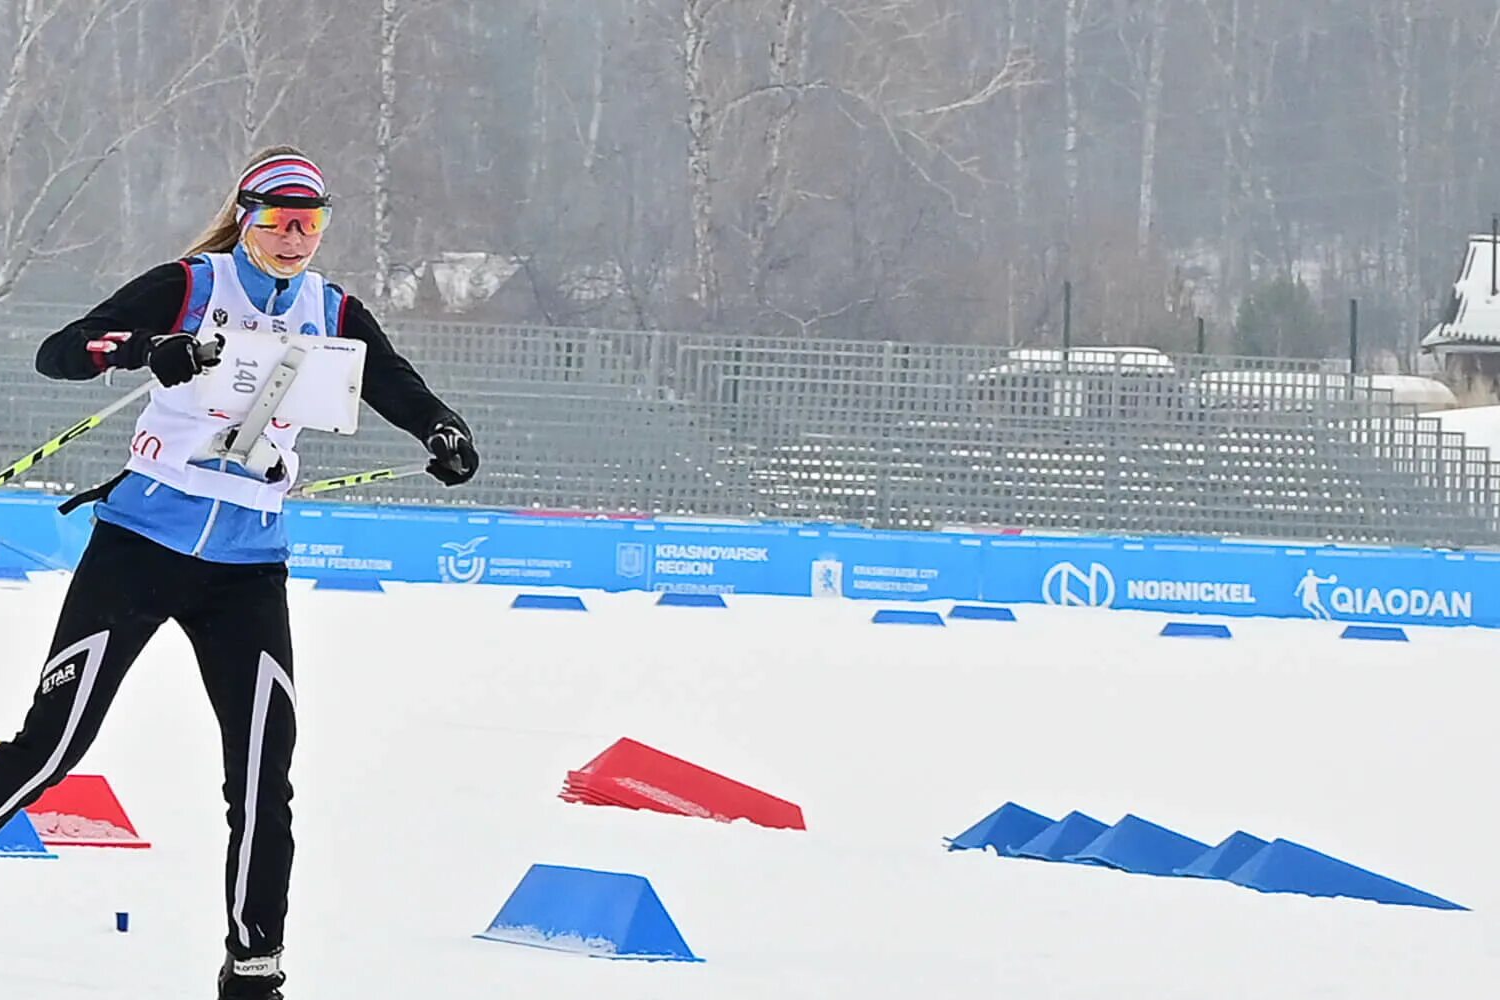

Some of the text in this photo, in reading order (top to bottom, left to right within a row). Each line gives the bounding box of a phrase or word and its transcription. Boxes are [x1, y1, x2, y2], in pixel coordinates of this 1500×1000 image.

[232, 357, 259, 394] 140
[654, 544, 769, 562] KRASNOYARSK
[654, 560, 715, 576] REGION
[1126, 579, 1256, 603] NORNICKEL
[1330, 586, 1473, 619] QIAODAN
